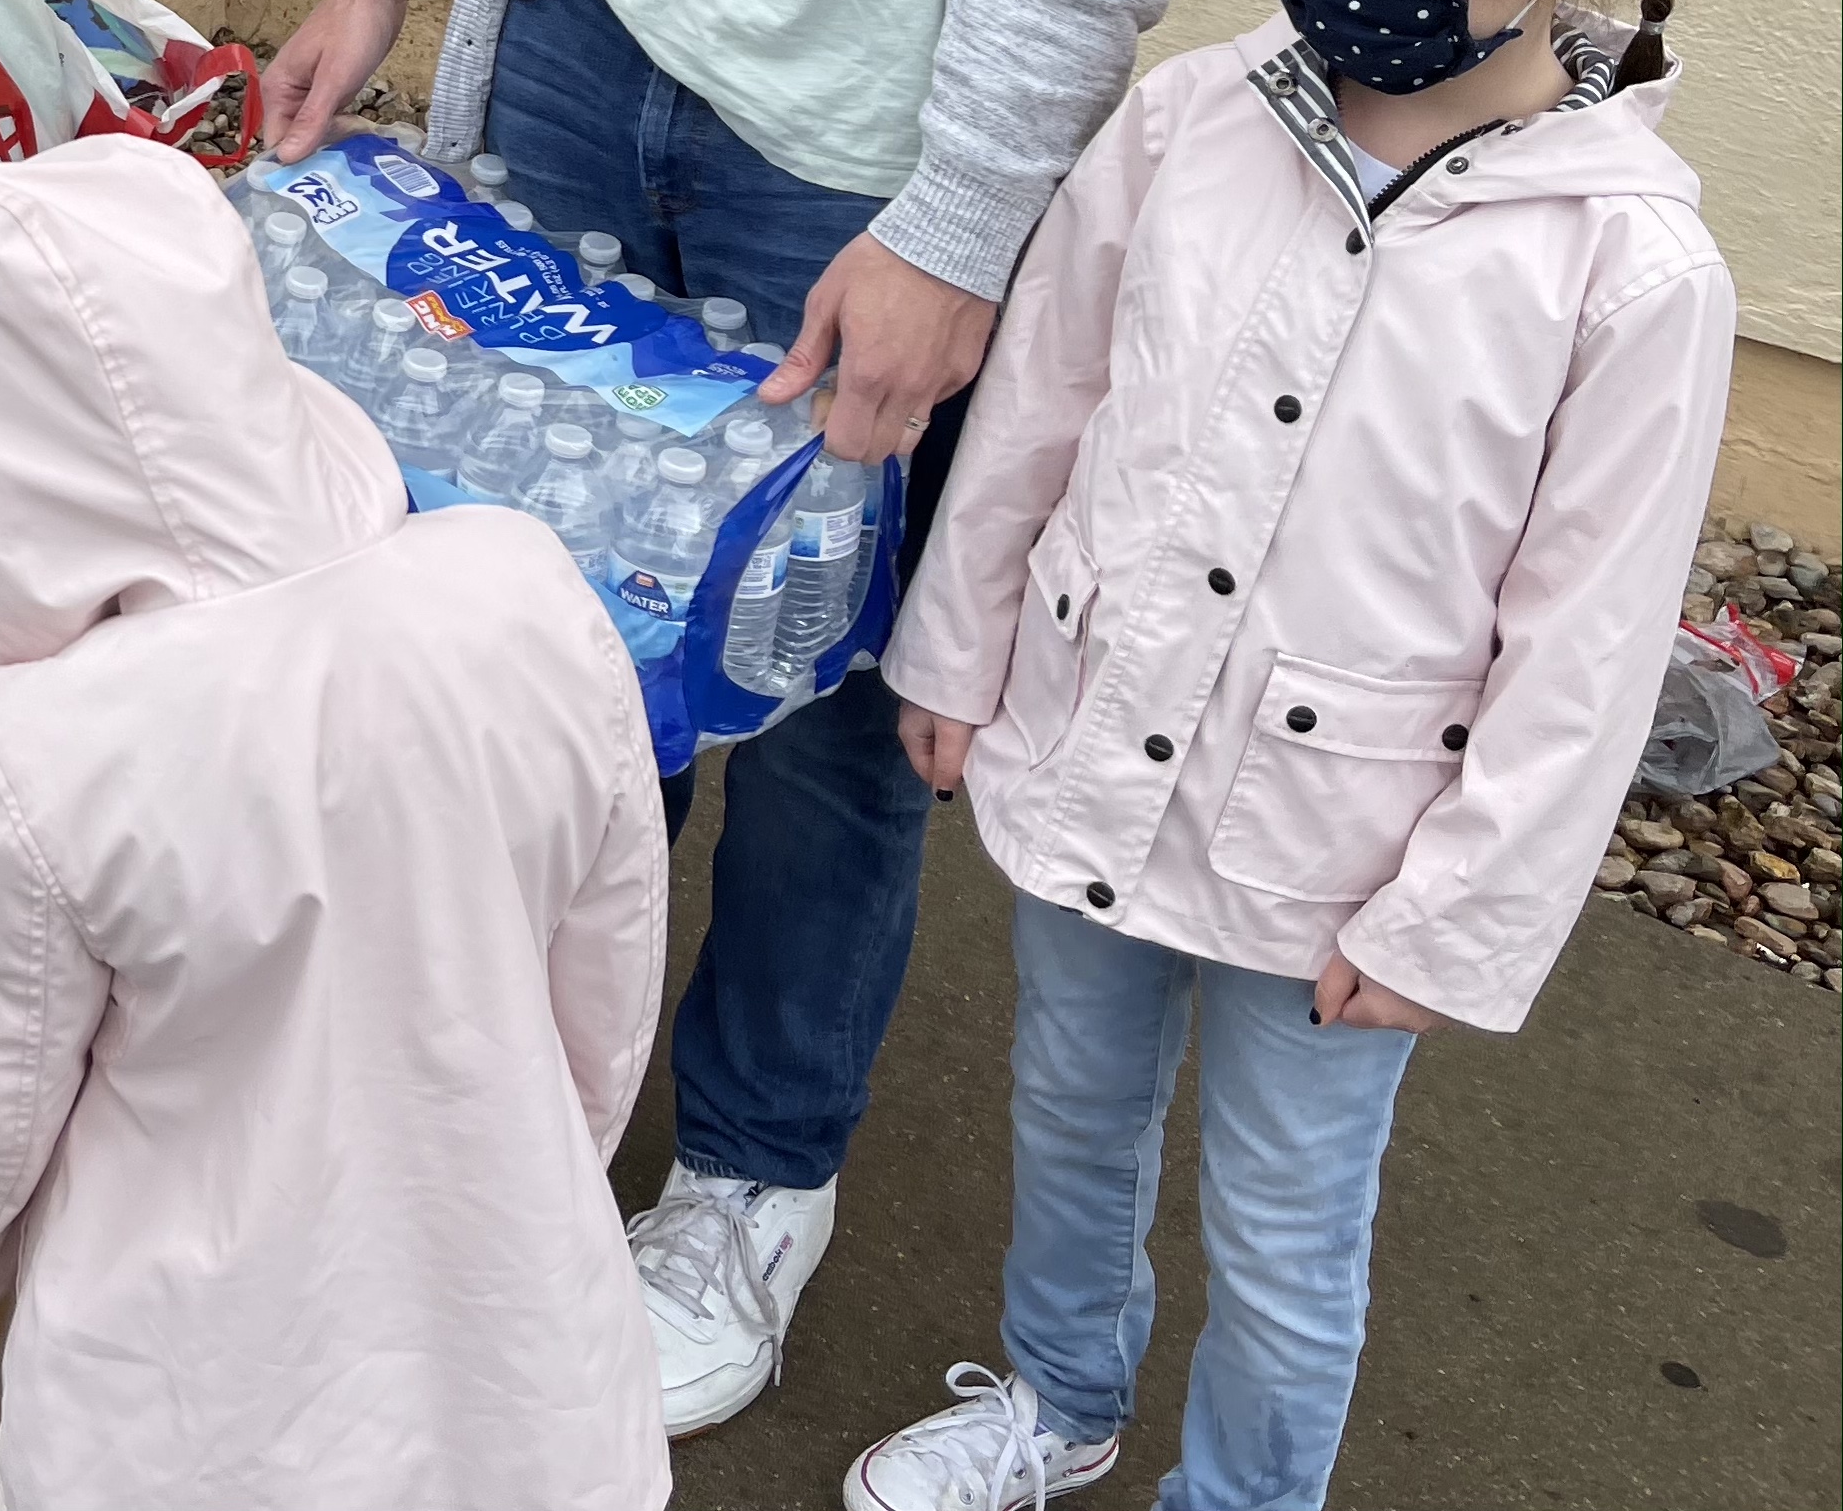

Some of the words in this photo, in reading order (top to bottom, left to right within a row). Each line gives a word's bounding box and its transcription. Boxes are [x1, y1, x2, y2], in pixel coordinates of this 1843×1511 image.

[287, 175, 335, 208] 32
[422, 220, 619, 344] WATER
[619, 587, 669, 614] WATER
[761, 1246, 784, 1283] eebok
